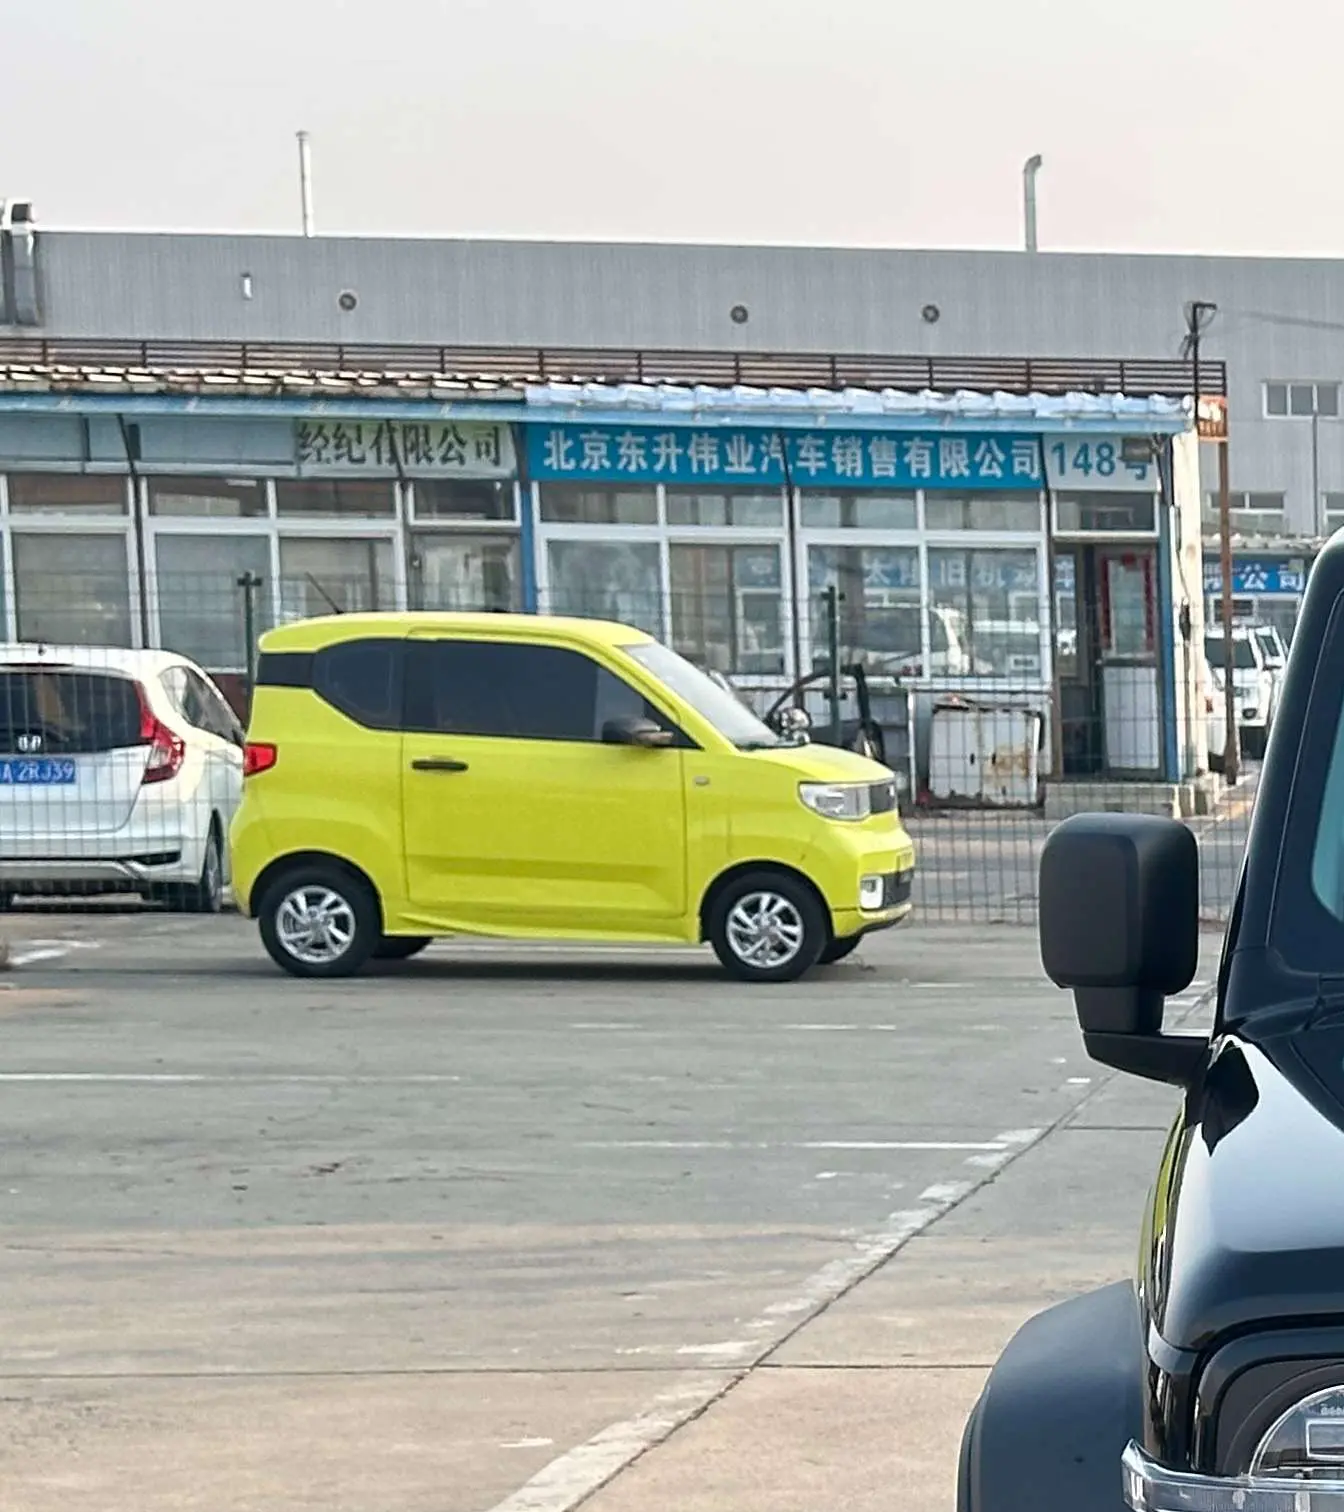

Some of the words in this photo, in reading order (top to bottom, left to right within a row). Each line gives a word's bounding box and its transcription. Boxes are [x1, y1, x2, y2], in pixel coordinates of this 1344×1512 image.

[544, 430, 1039, 479] 北京东升伟业汽车销售有限公司
